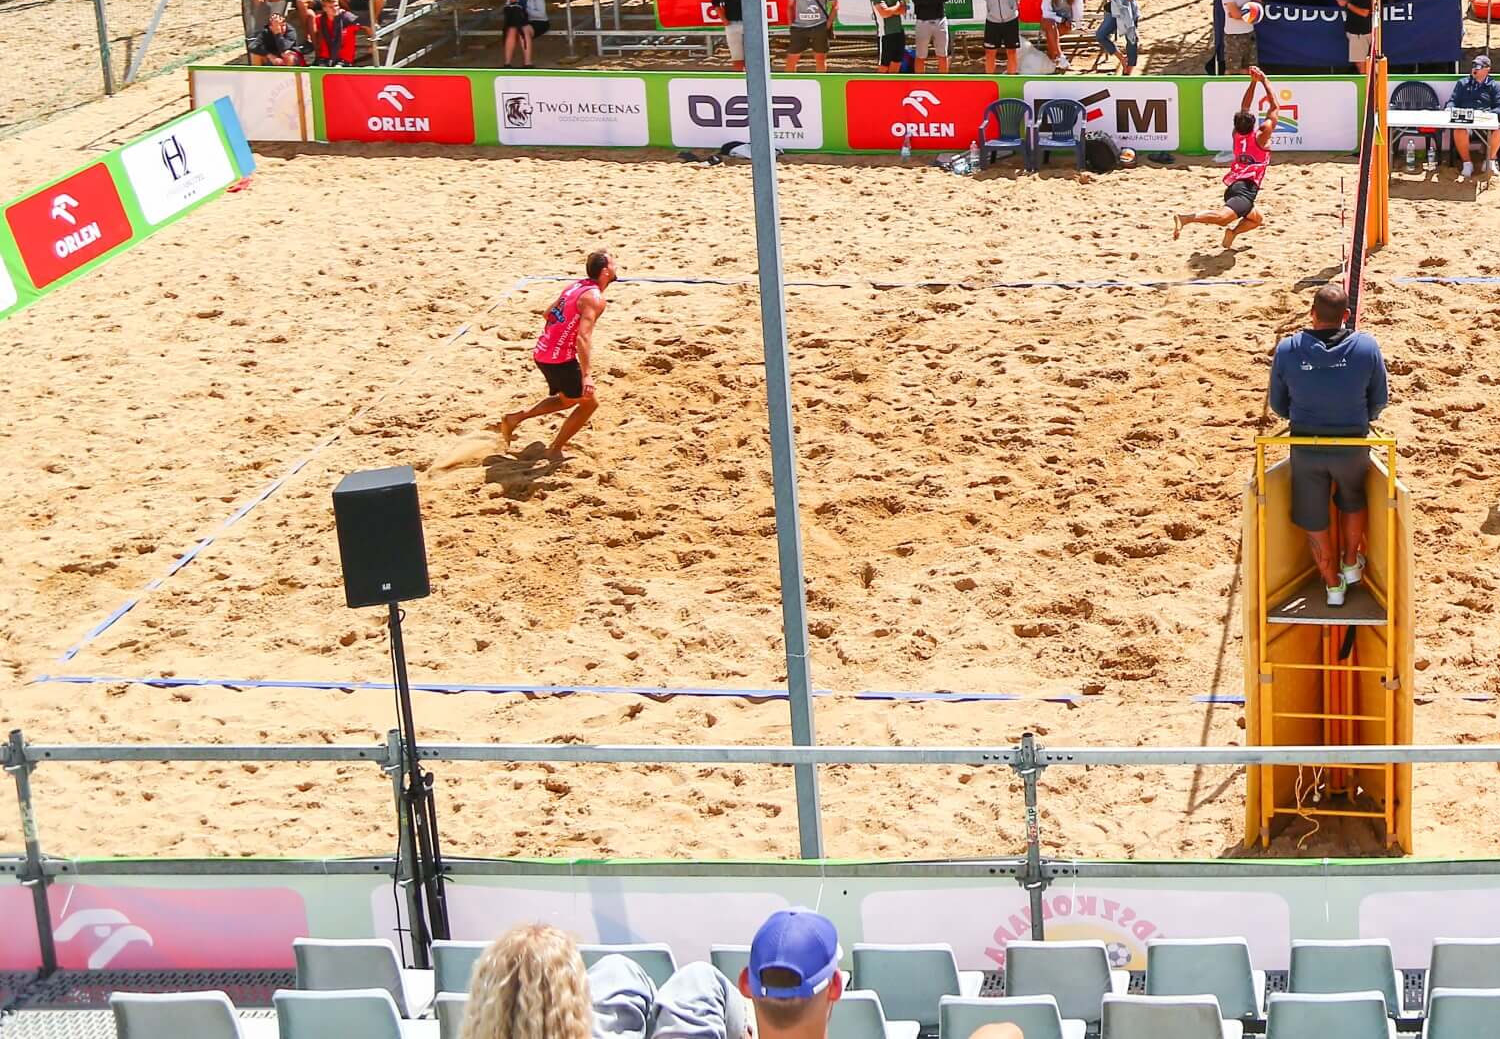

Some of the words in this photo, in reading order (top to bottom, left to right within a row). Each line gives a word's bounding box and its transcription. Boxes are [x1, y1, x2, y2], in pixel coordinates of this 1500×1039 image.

[535, 100, 574, 116] TWÓJ
[577, 101, 641, 115] MECENAS
[367, 116, 430, 132] ORLEN
[890, 121, 955, 138] ORLEN
[55, 221, 102, 259] ORLEN
